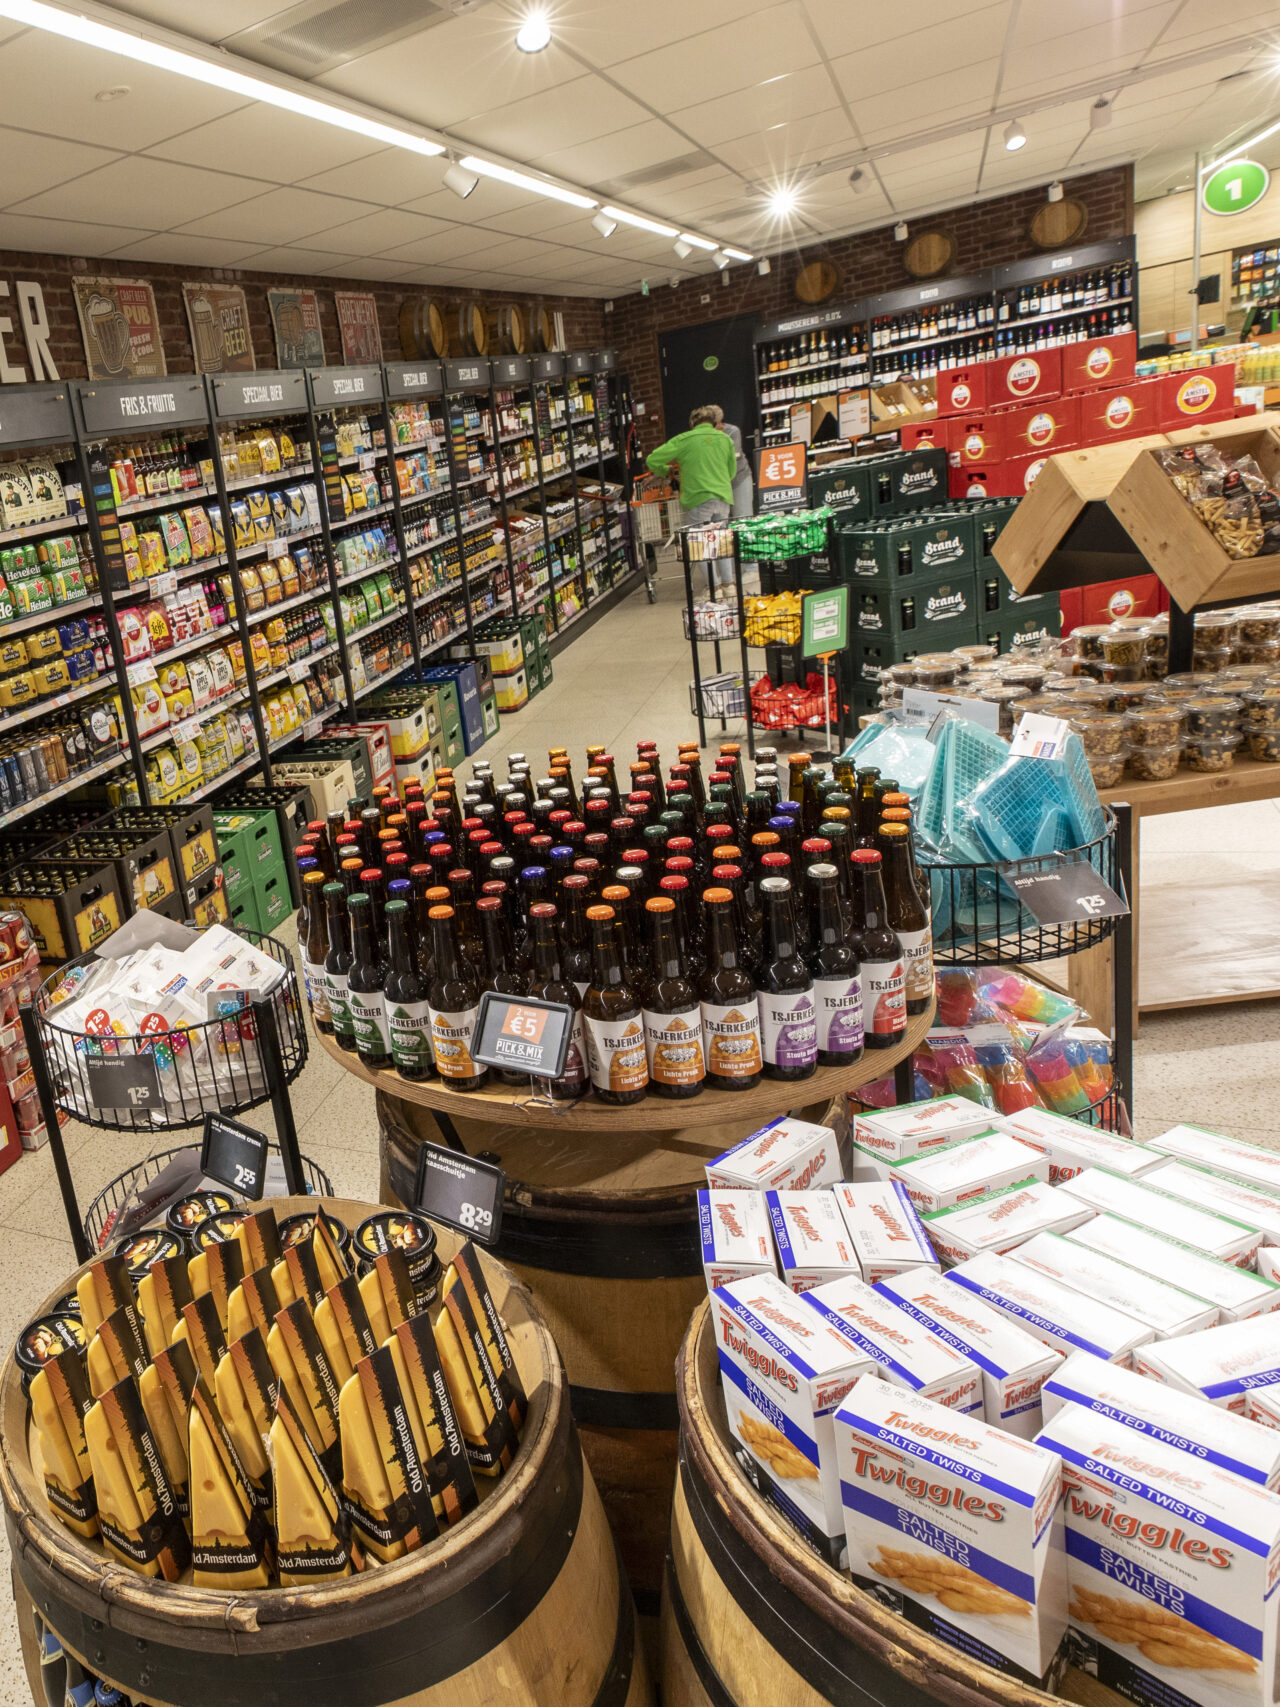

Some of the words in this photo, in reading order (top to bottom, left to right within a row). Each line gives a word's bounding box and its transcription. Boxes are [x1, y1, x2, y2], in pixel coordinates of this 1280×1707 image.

[1224, 178, 1243, 201] 1
[120, 290, 134, 300] CRAFT
[135, 290, 146, 299] BEER
[123, 306, 150, 325] PUB
[220, 306, 242, 329] CRAFT
[129, 333, 150, 345] FRESH
[224, 329, 247, 357] BEER
[132, 347, 138, 363] &
[138, 345, 154, 356] COOL
[243, 387, 269, 403] SPECIAAL
[269, 385, 283, 401] BIER
[354, 378, 364, 392] BIER
[120, 397, 139, 416] FRIS
[140, 396, 148, 414] &
[148, 394, 175, 414] FRUITIG
[769, 454, 775, 462] 3
[766, 460, 796, 480] €5
[928, 592, 963, 611] Brand
[517, 1008, 522, 1016] 2
[510, 1016, 537, 1036] €5
[648, 1024, 702, 1041] TSJERKEBIER
[704, 1016, 758, 1033] TSJERKEBIER
[439, 1155, 476, 1174] Amsterdam
[838, 1304, 913, 1346] Twiggles
[912, 1293, 991, 1335] Twiggles
[719, 1317, 798, 1392] Twiggles
[433, 1370, 453, 1435] Amsterdam
[394, 1404, 416, 1470] Amsterdam
[883, 1410, 982, 1450] Twiggles
[1091, 1401, 1147, 1430] SALTED
[1151, 1426, 1208, 1458] TWISTS
[448, 1434, 461, 1456] Old
[878, 1429, 927, 1456] SALTED
[931, 1452, 982, 1482] TWISTS
[407, 1468, 423, 1493] Old
[851, 1448, 1007, 1522] Twiggles
[1084, 1460, 1143, 1493] SALTED
[1147, 1489, 1207, 1525] TWISTS
[945, 1515, 978, 1535] PASTRIES
[898, 1519, 972, 1568] TWISTS
[1099, 1546, 1186, 1606] SALTED
